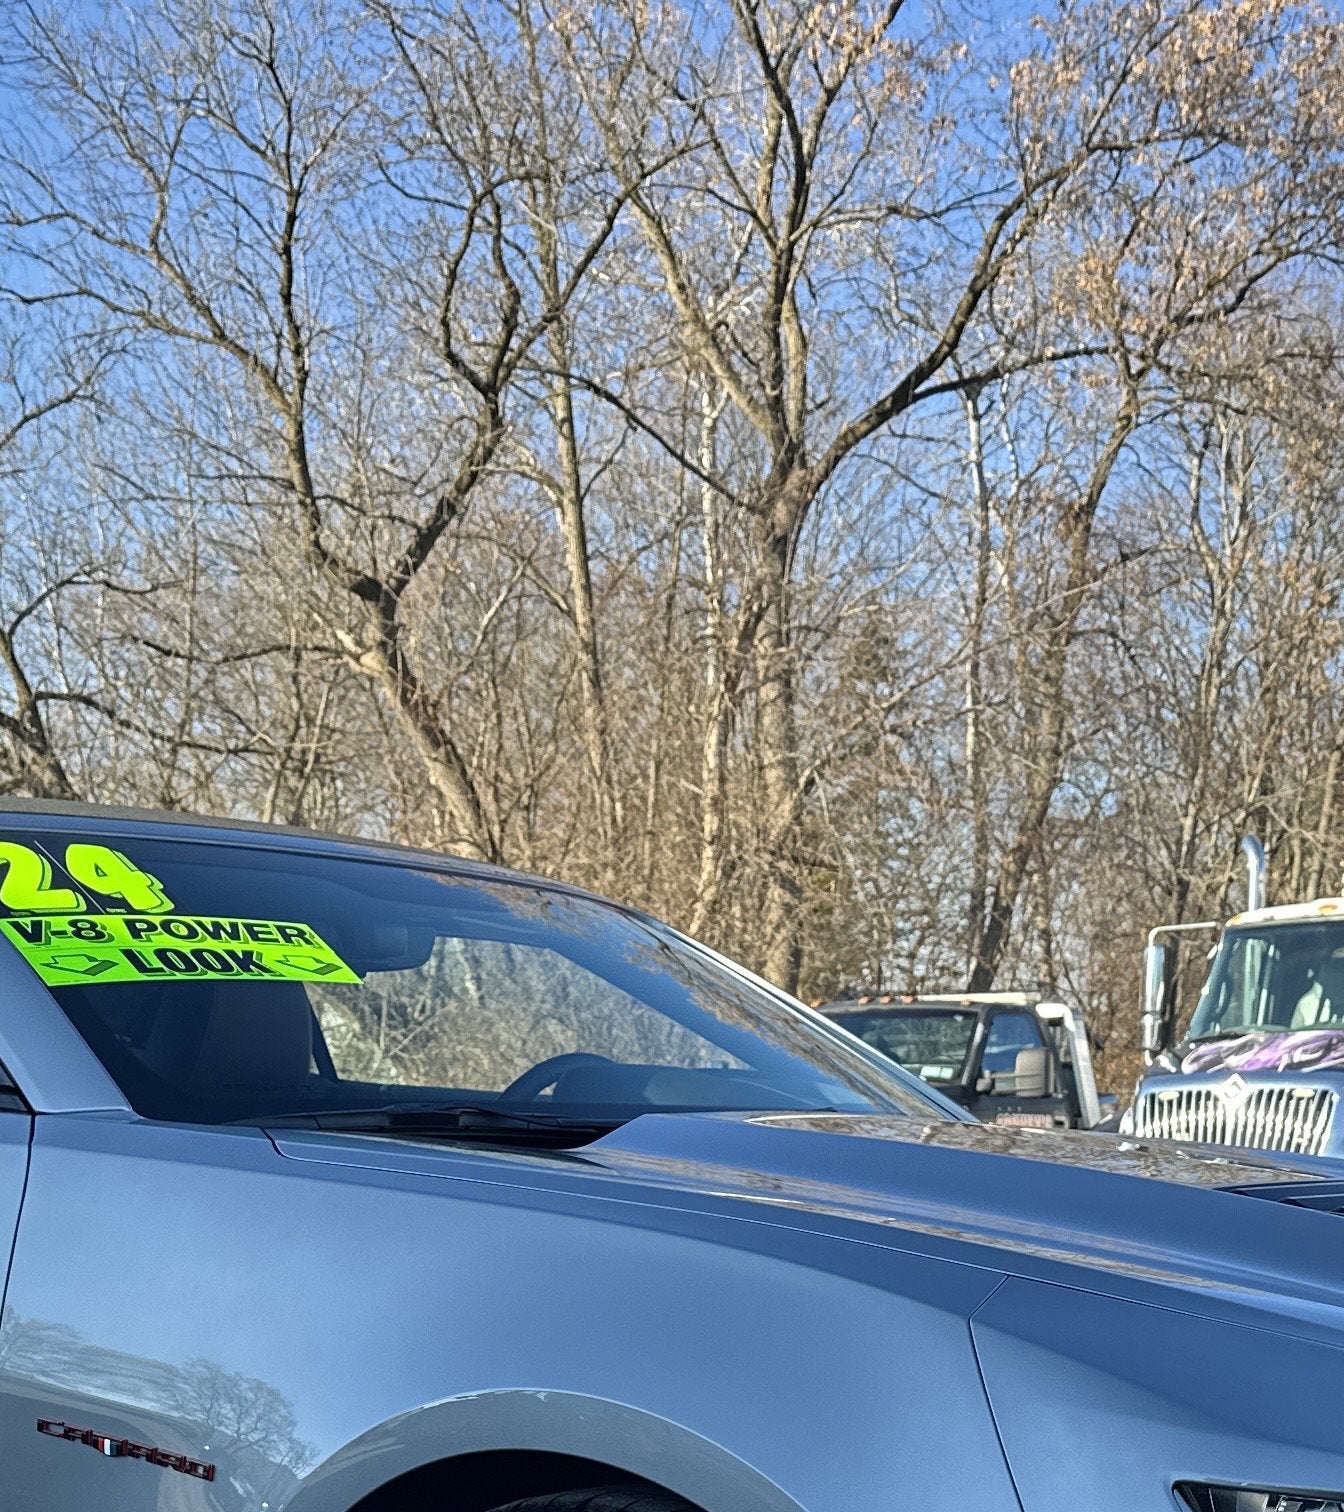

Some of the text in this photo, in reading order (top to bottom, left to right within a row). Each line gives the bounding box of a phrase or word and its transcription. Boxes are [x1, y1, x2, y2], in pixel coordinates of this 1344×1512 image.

[8, 917, 324, 949] V-8 POWER
[123, 948, 278, 978] LOOK
